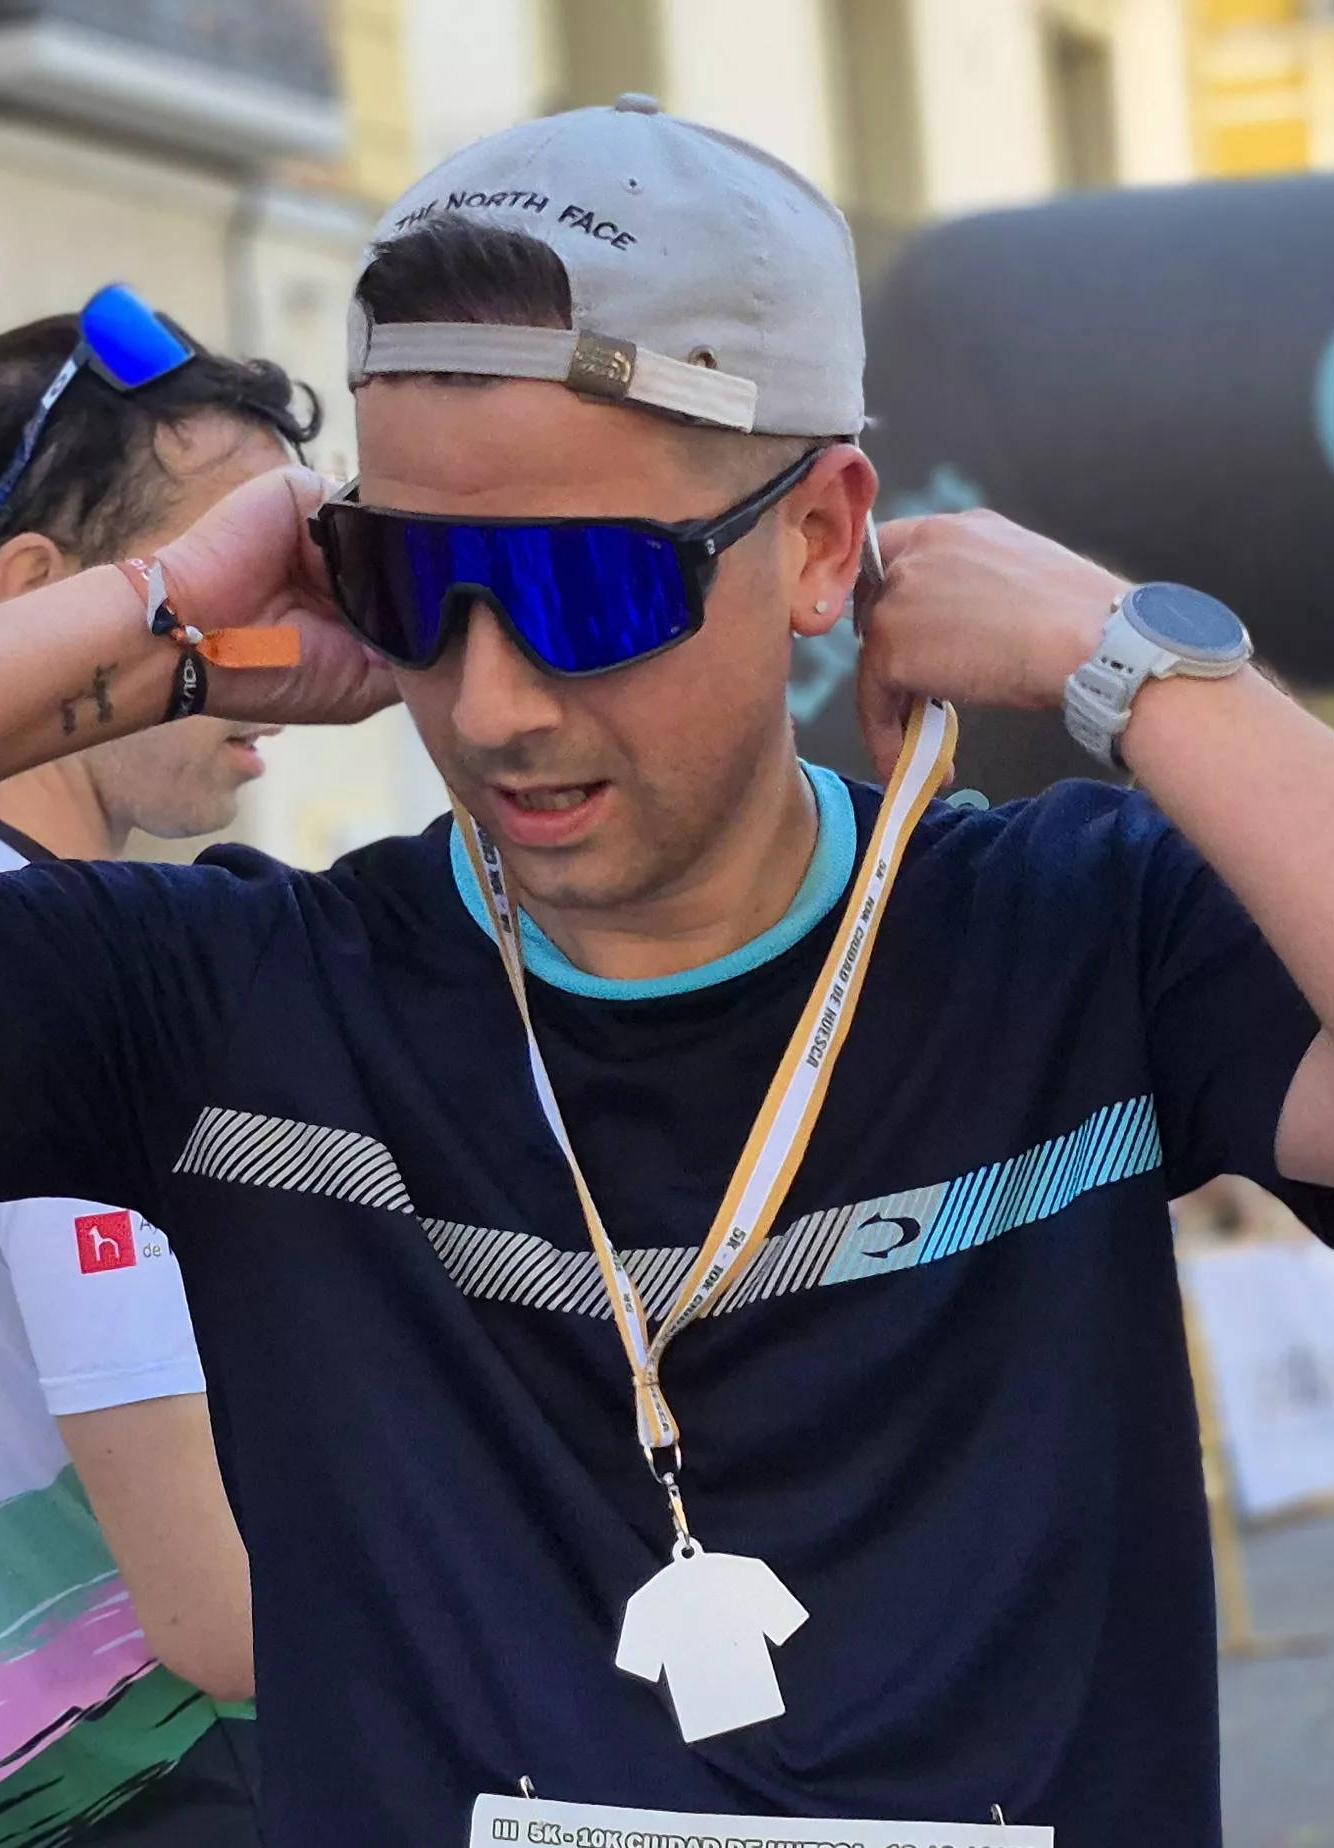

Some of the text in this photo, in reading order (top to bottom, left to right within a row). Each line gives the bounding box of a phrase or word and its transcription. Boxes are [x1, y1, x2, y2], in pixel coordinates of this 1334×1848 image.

[445, 191, 550, 214] NORTH
[558, 204, 638, 251] FACE
[838, 926, 865, 983] CIUDAD
[829, 983, 845, 1007] DE
[806, 1007, 838, 1069] HUESCA
[142, 1242, 161, 1258] de
[726, 1226, 747, 1251] 5K
[528, 1821, 562, 1845] 5K
[576, 1827, 623, 1848] 10K
